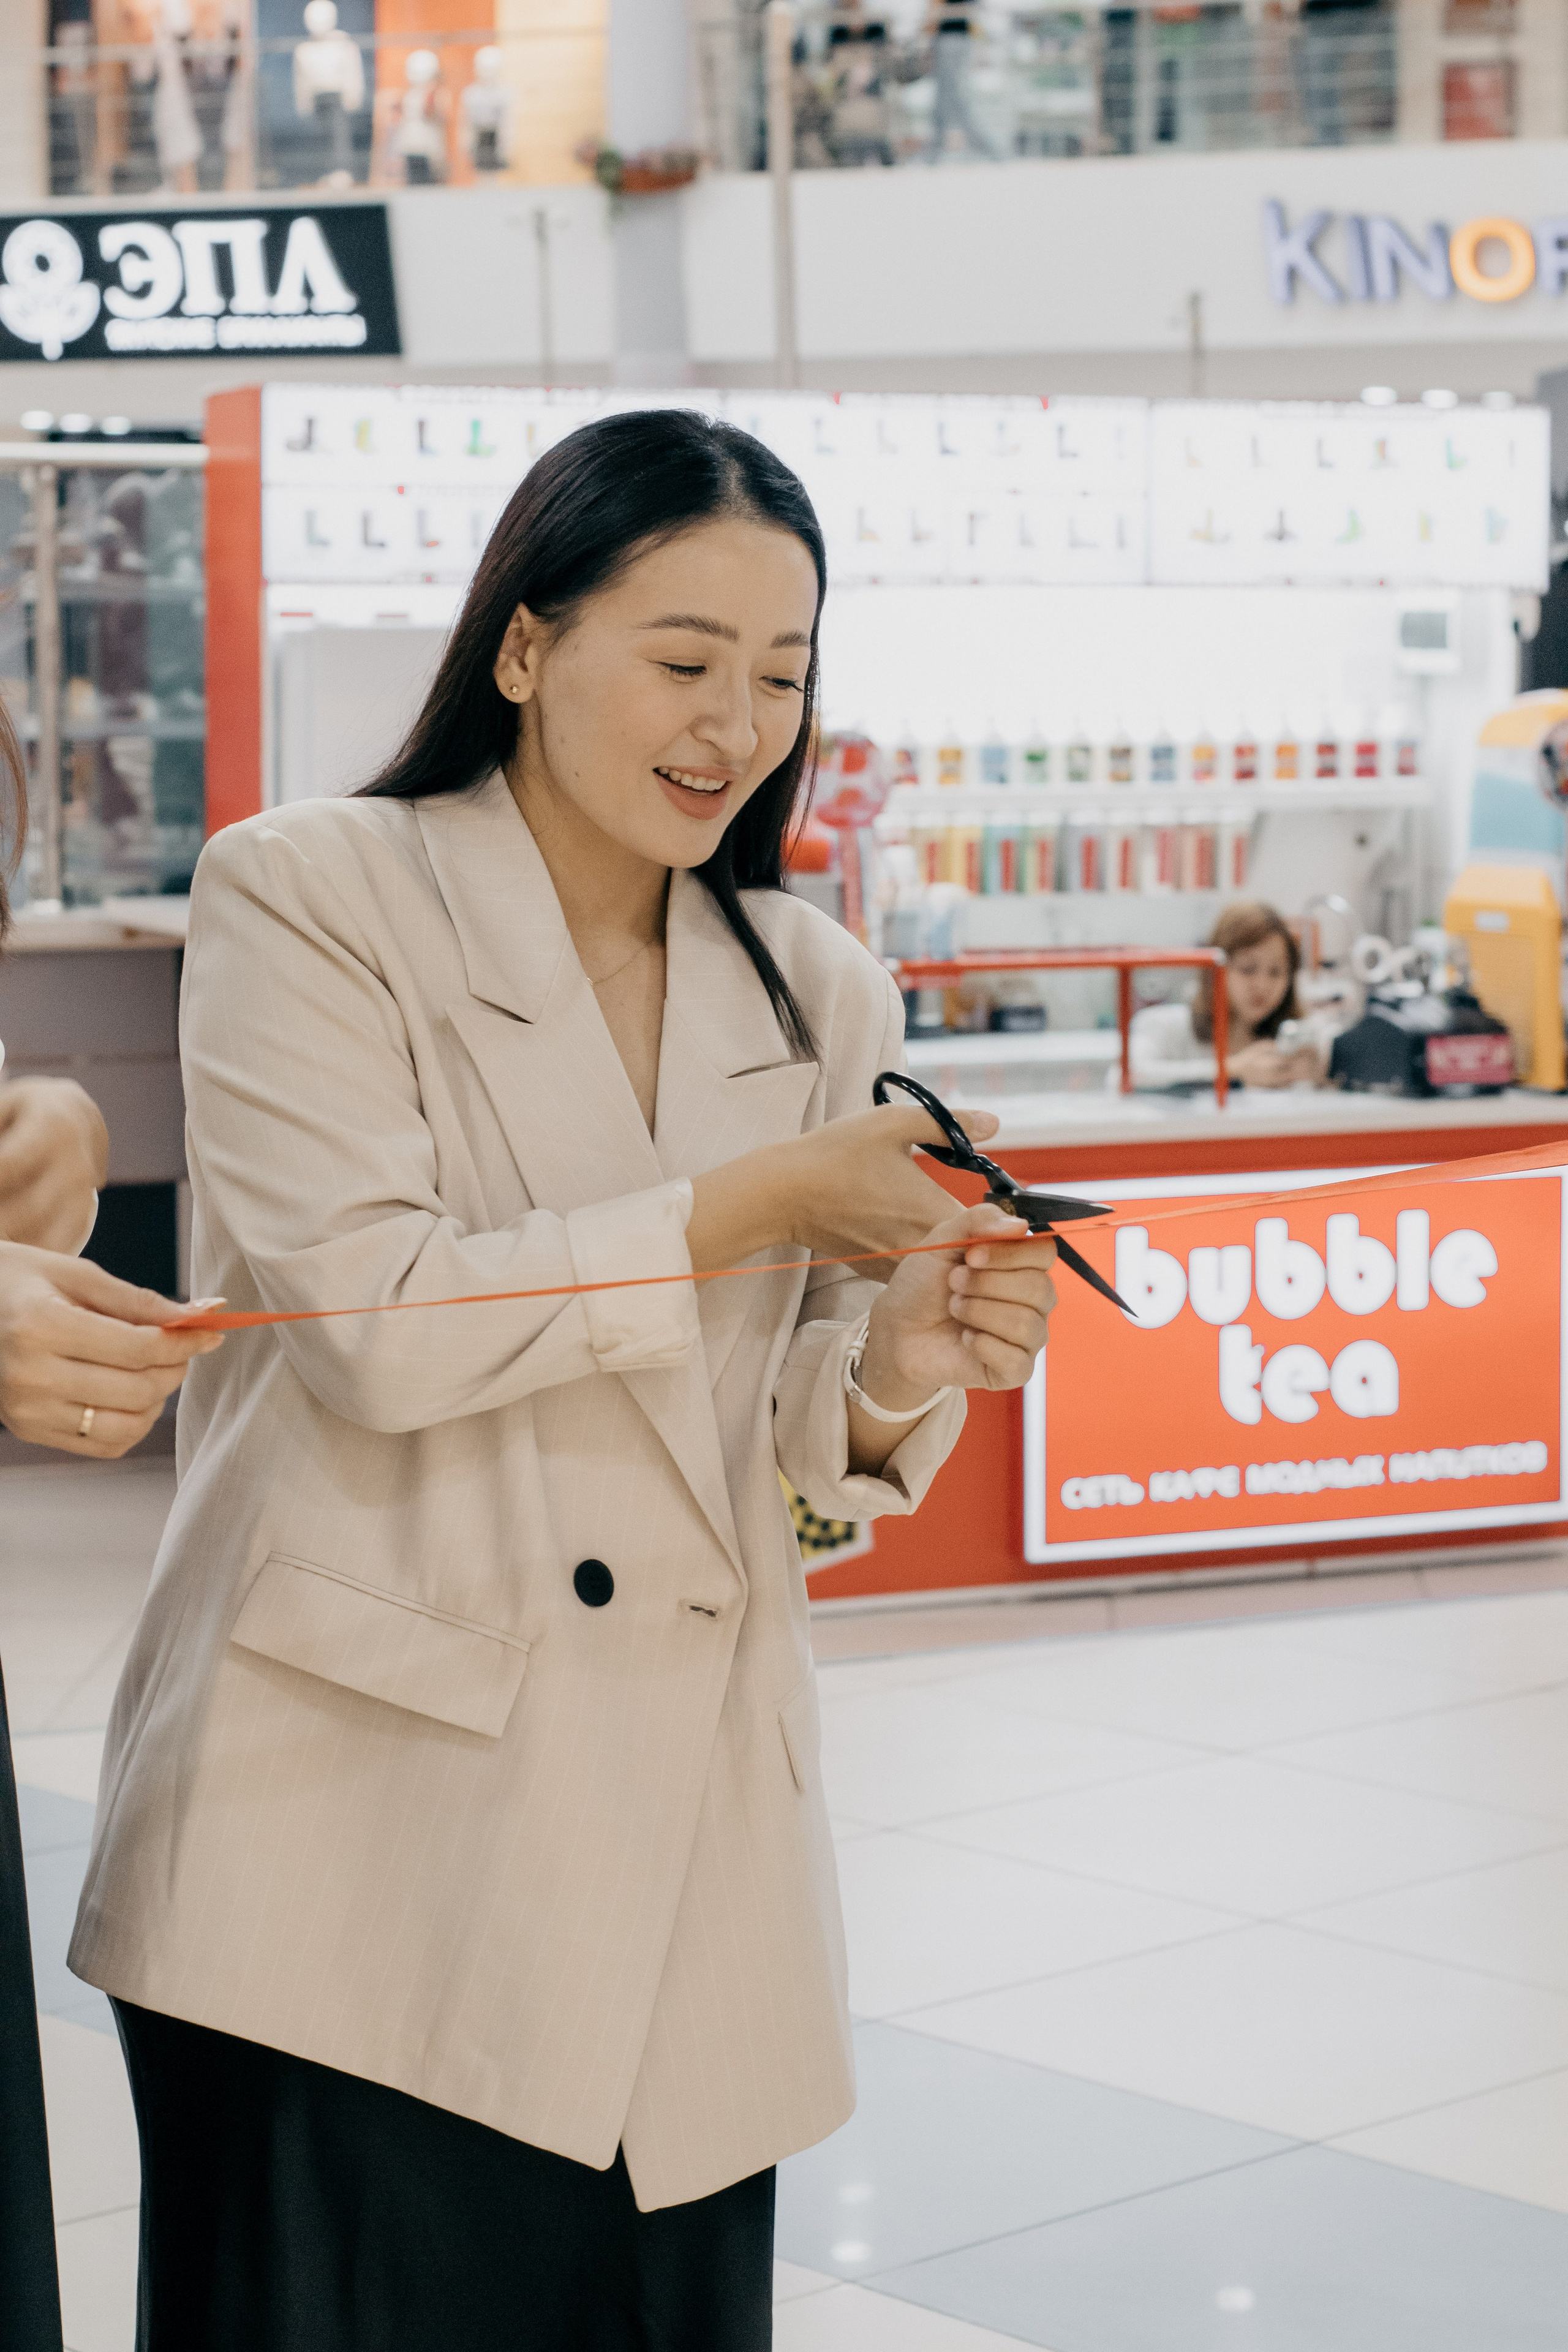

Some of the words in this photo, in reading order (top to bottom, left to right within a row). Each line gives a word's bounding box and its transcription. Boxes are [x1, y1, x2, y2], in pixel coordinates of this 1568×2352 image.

[99, 217, 358, 319] ЭПЛ
[1115, 1209, 1498, 1329] bubble
[1219, 1324, 1400, 1425] tea
